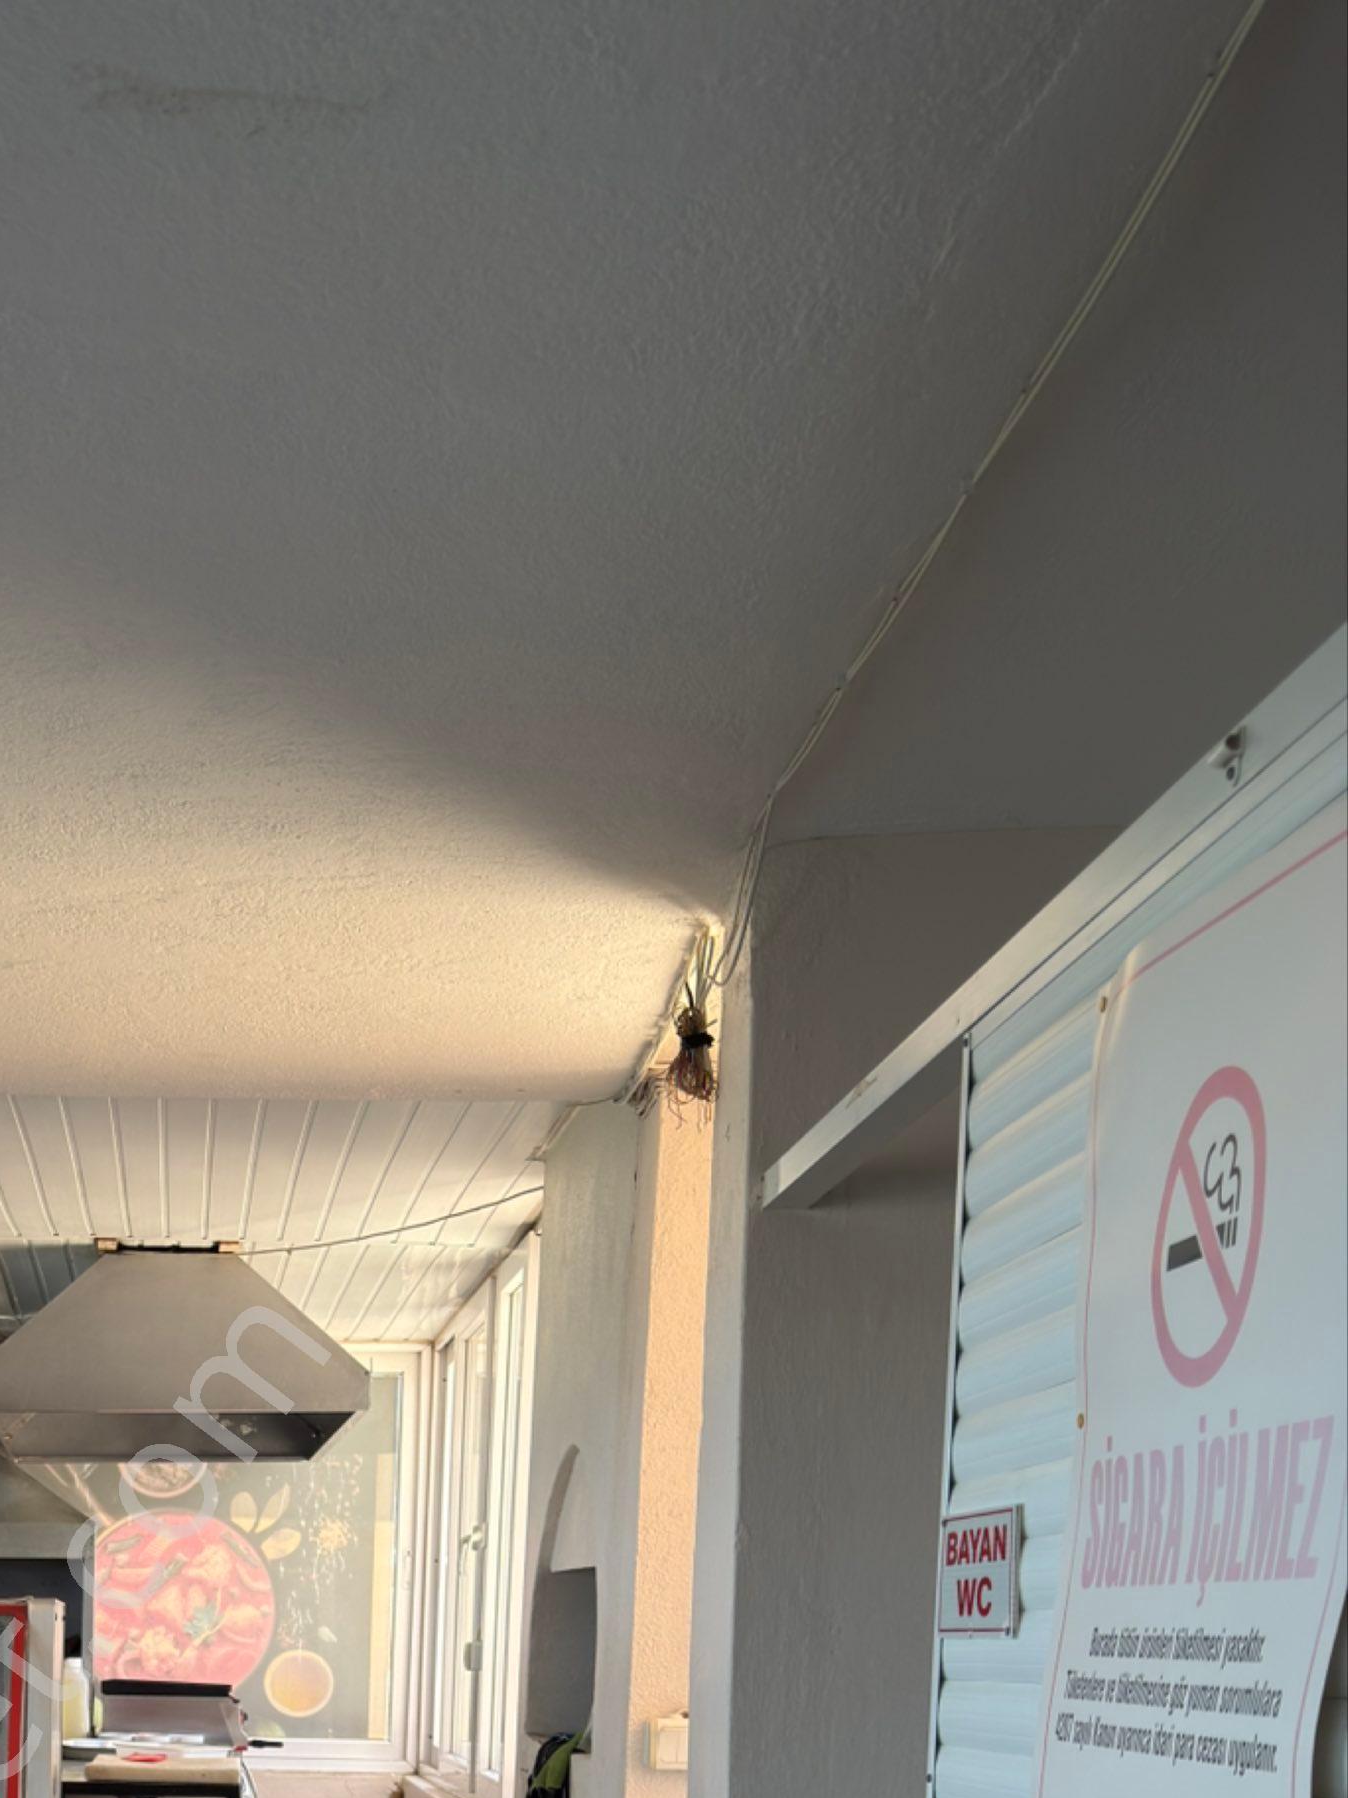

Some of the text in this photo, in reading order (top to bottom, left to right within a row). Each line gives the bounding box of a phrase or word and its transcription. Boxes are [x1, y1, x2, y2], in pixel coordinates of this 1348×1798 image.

[1081, 1408, 1335, 1608] SİGARA İÇİLMEZ
[946, 1525, 1008, 1566] BAYAN
[957, 1576, 993, 1617] WC
[1089, 1627, 1120, 1658] Burada
[1168, 1675, 1190, 1716] göz
[1092, 1716, 1119, 1749] Kanun
[1171, 1731, 1196, 1767] para
[1195, 1735, 1229, 1766] cezası
